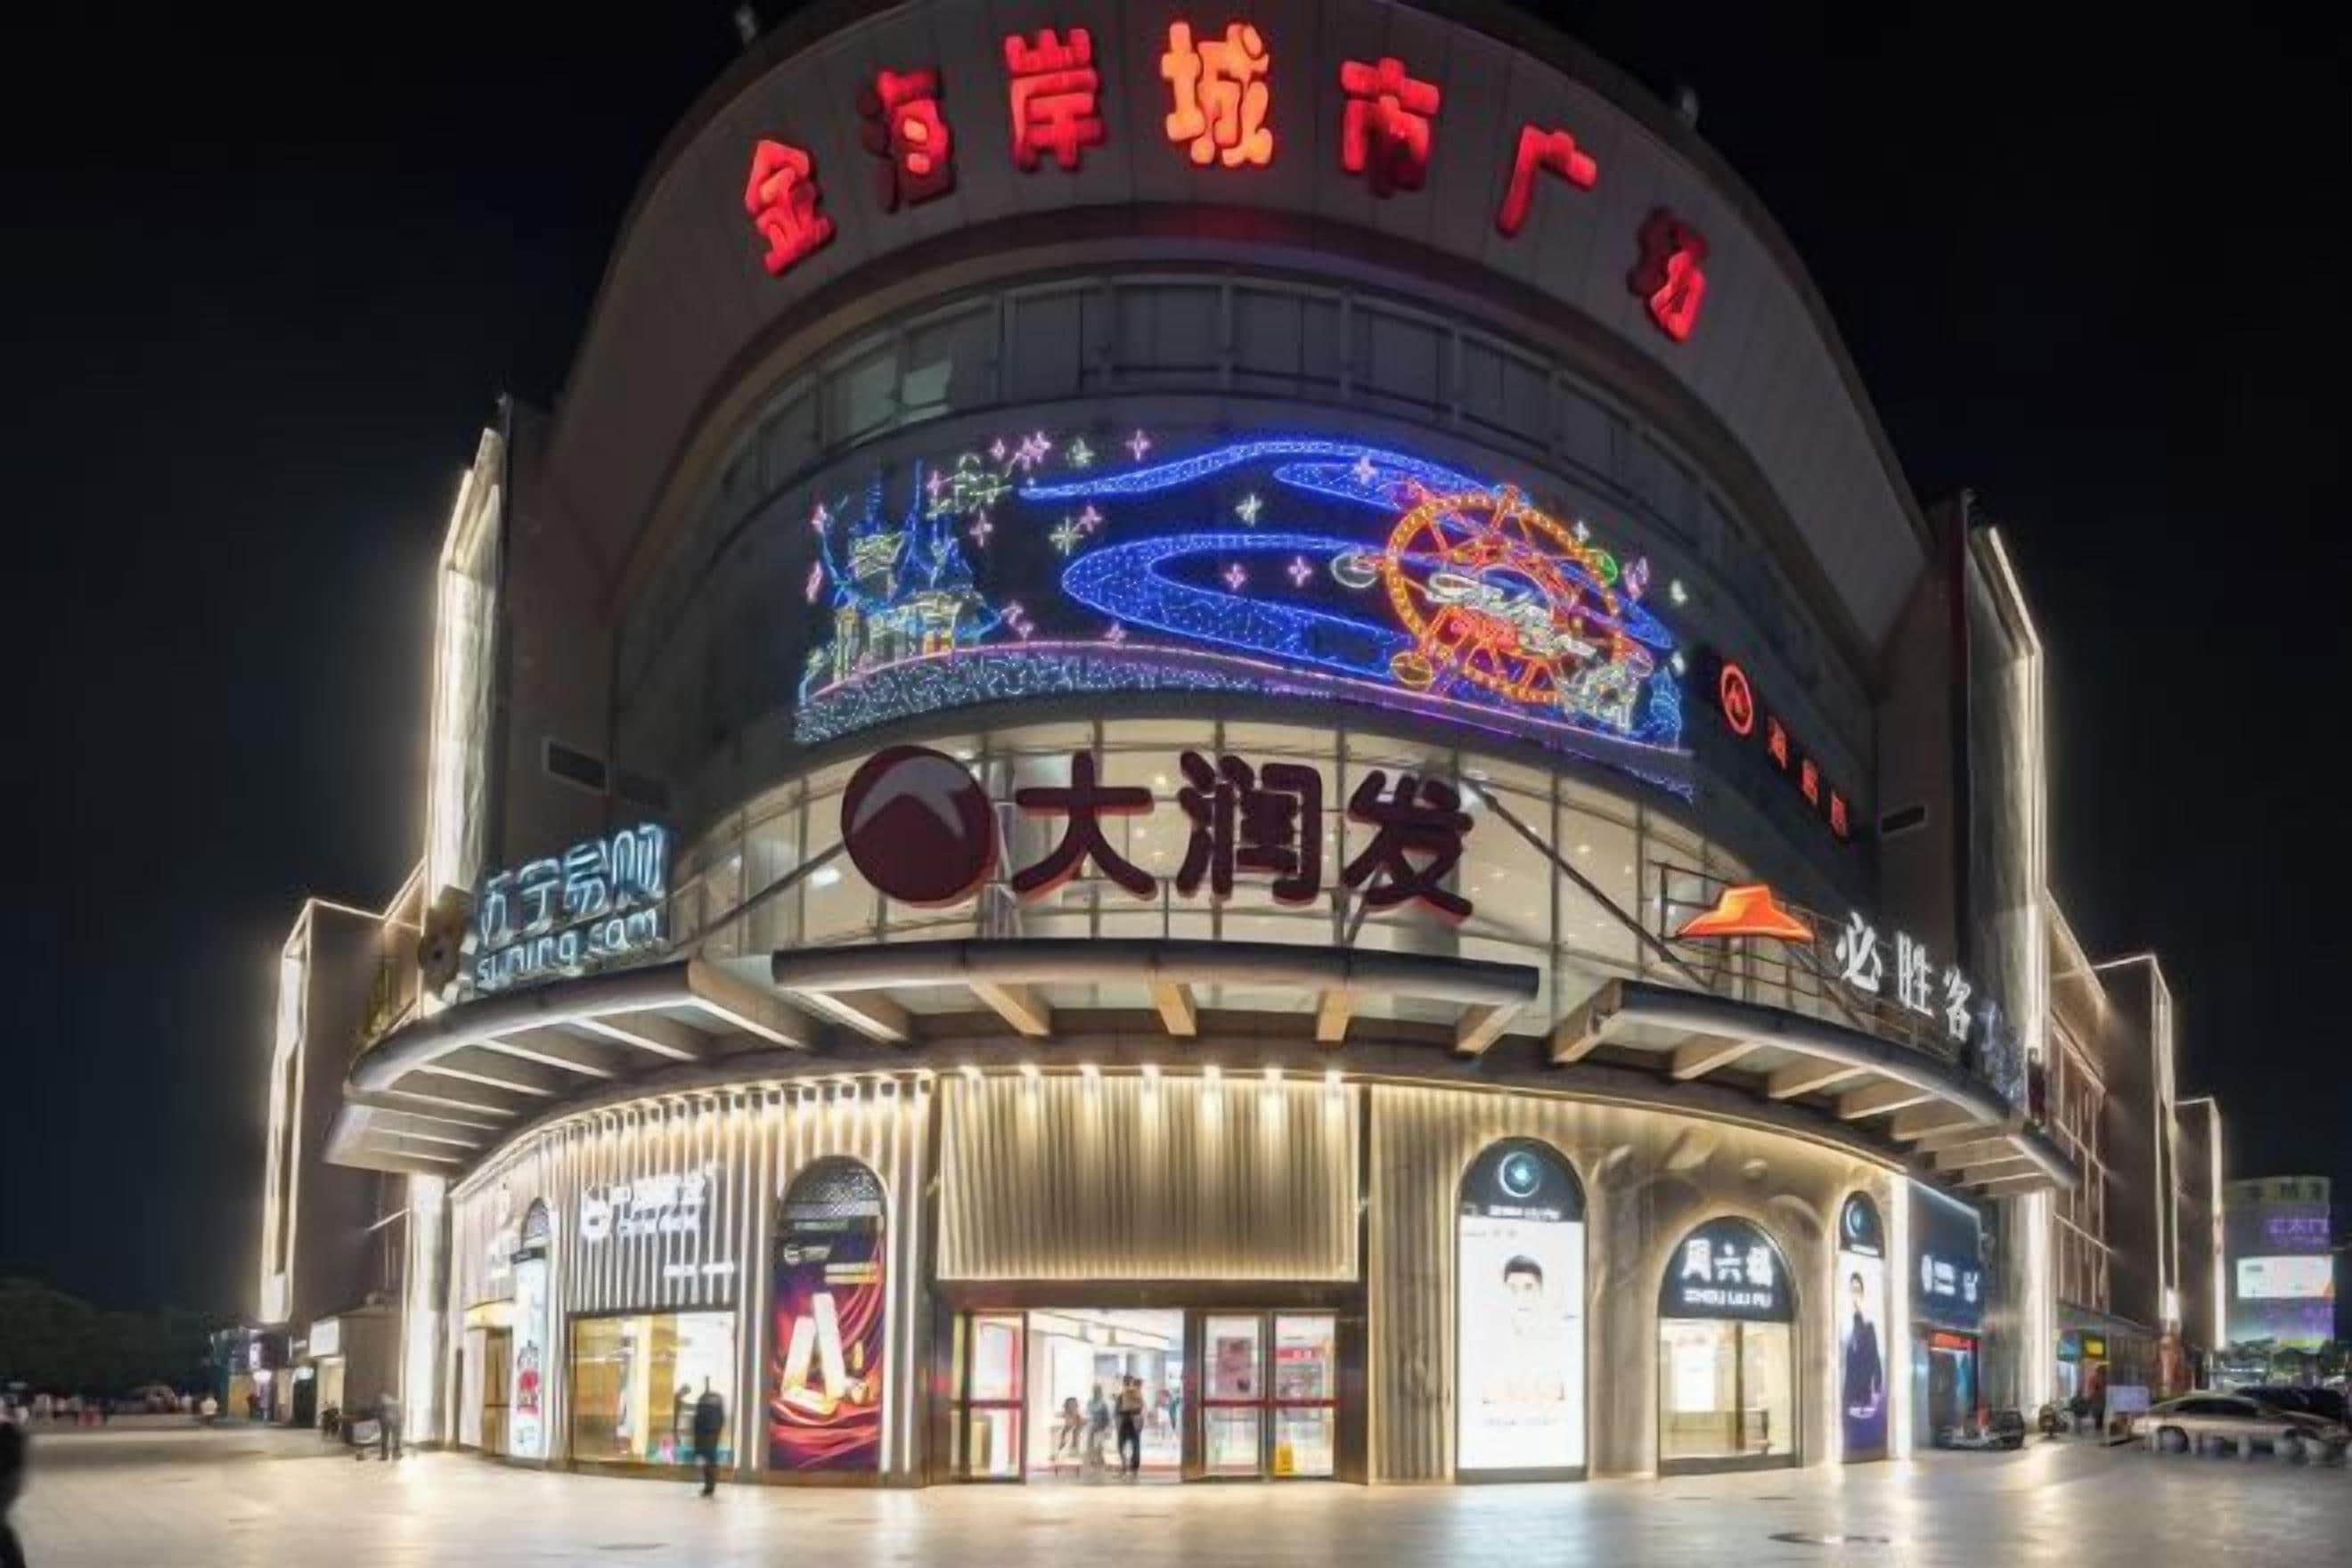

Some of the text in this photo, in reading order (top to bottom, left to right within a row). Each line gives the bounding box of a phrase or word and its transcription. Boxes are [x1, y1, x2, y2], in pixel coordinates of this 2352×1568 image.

[744, 21, 1708, 342] 金海岸城市广场
[1012, 749, 1474, 919] 大润发
[1835, 910, 1972, 1041] 必胜客
